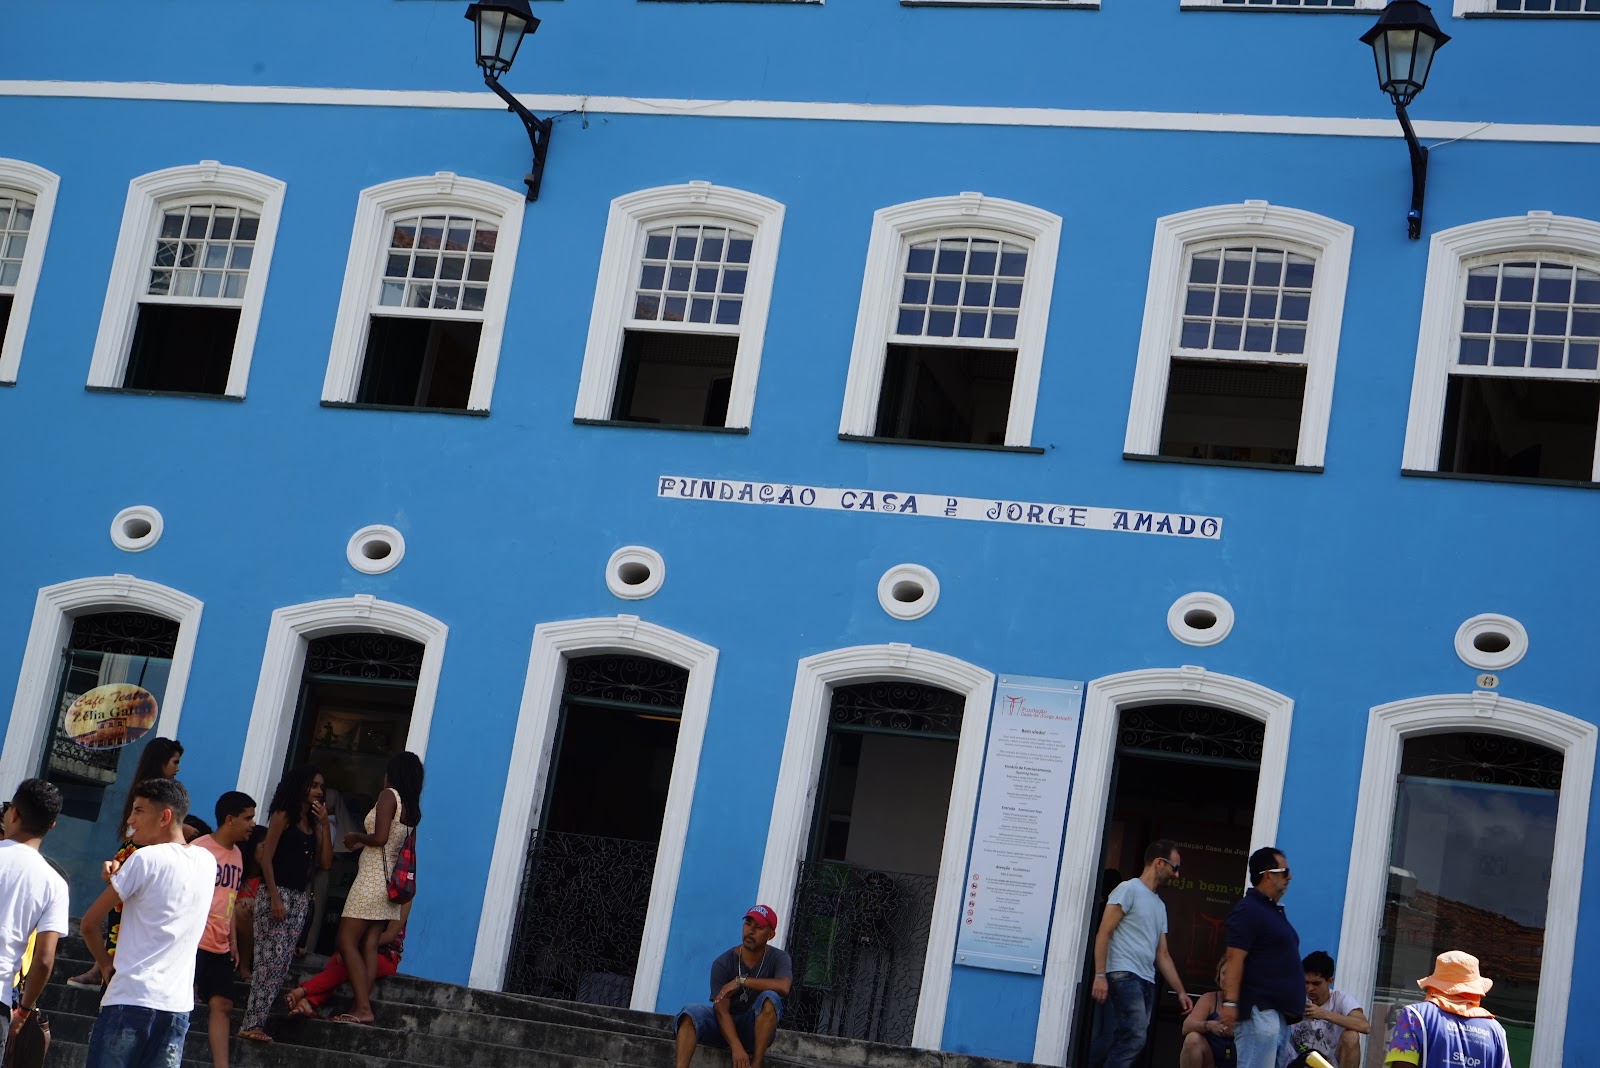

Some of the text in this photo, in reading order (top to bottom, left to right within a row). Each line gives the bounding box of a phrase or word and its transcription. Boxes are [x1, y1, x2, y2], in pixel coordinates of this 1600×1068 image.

[659, 476, 817, 504] FUNDAÇÃO
[840, 490, 919, 513] CASA
[986, 501, 1086, 526] JORGE
[1112, 511, 1218, 538] AMADO
[74, 694, 105, 708] Café
[72, 710, 105, 722] Zélia
[1172, 877, 1243, 895] eja bem-v
